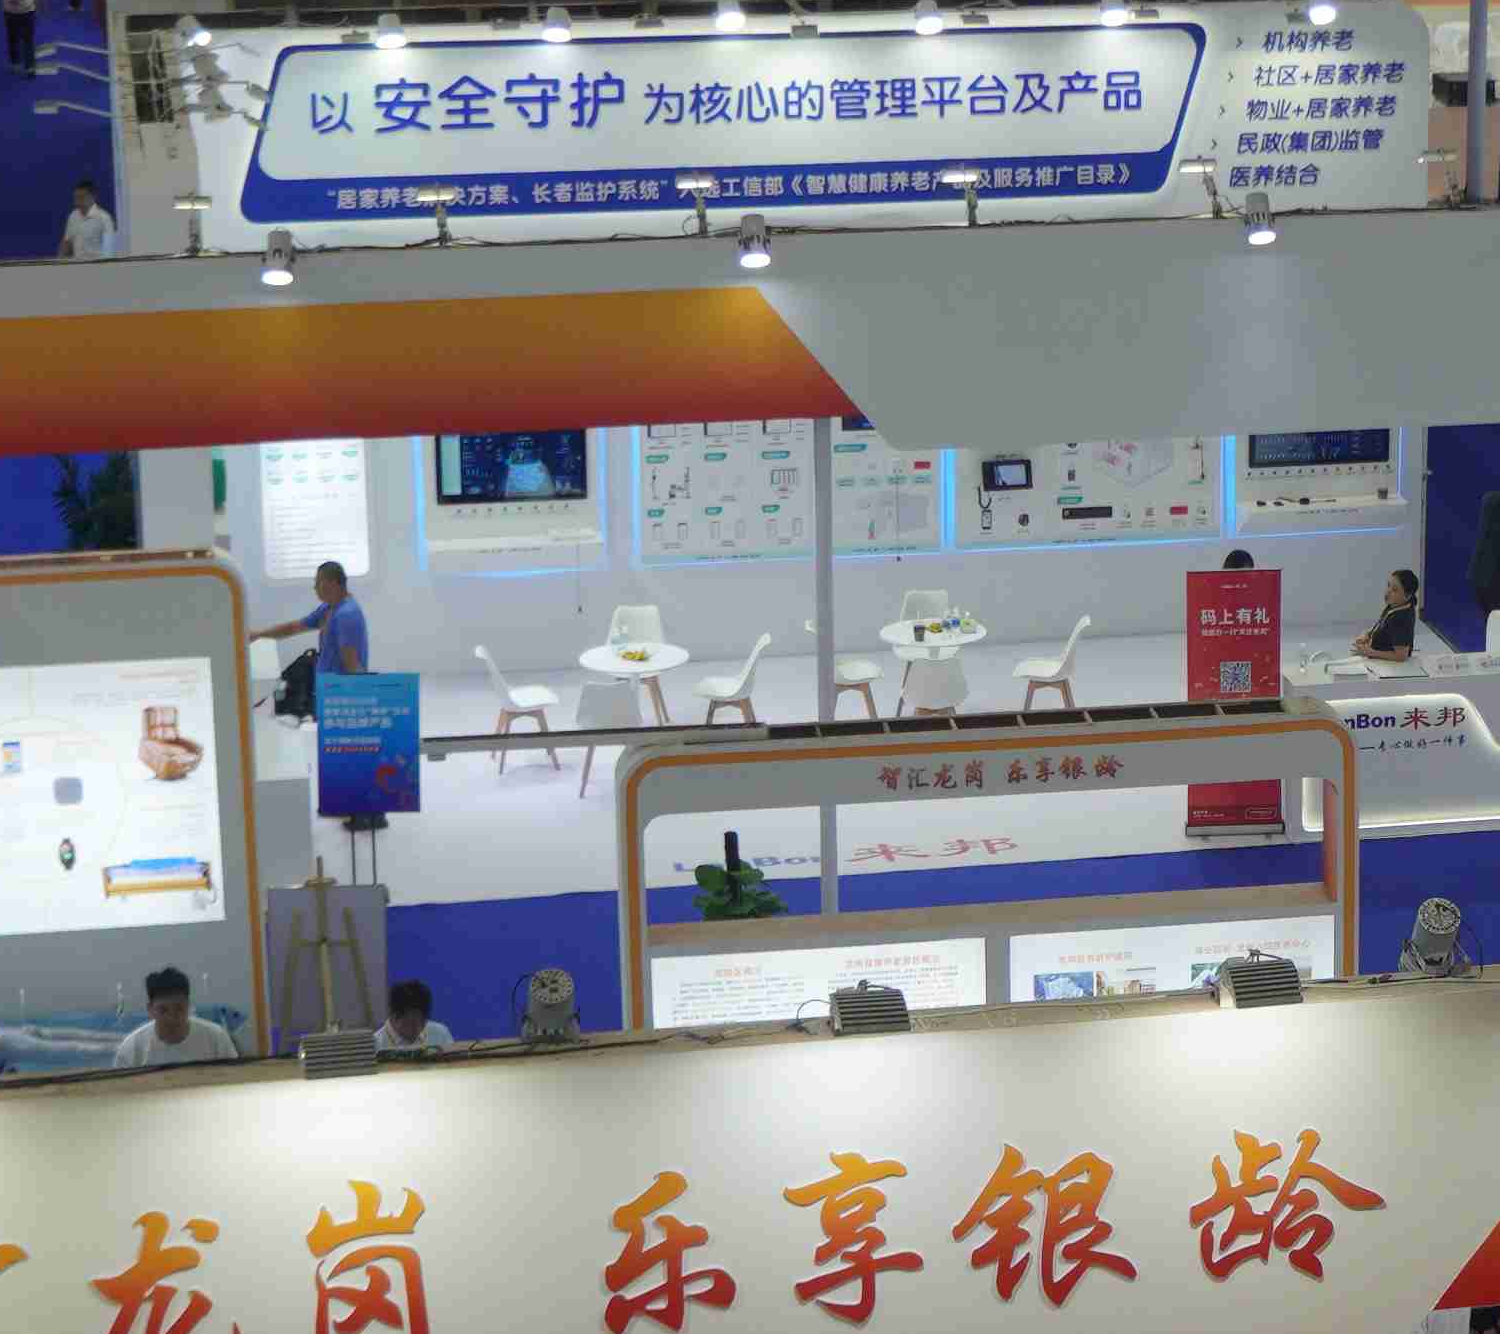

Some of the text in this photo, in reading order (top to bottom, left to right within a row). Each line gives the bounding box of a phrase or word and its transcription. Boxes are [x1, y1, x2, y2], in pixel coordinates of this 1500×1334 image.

[1261, 28, 1354, 53] 机构养老
[1253, 61, 1405, 87] 社区+居家养老
[309, 69, 1144, 135] 以安全守护为核心的管理平台及产品
[1245, 95, 1397, 121] 物业+居家养老
[1236, 127, 1384, 155] 民政(集团)监管
[1228, 164, 1321, 190] 医养结合
[1200, 607, 1270, 626] 码上有礼
[1399, 706, 1466, 729] 来邦
[877, 753, 1125, 792] 智汇龙岗 乐享银龄
